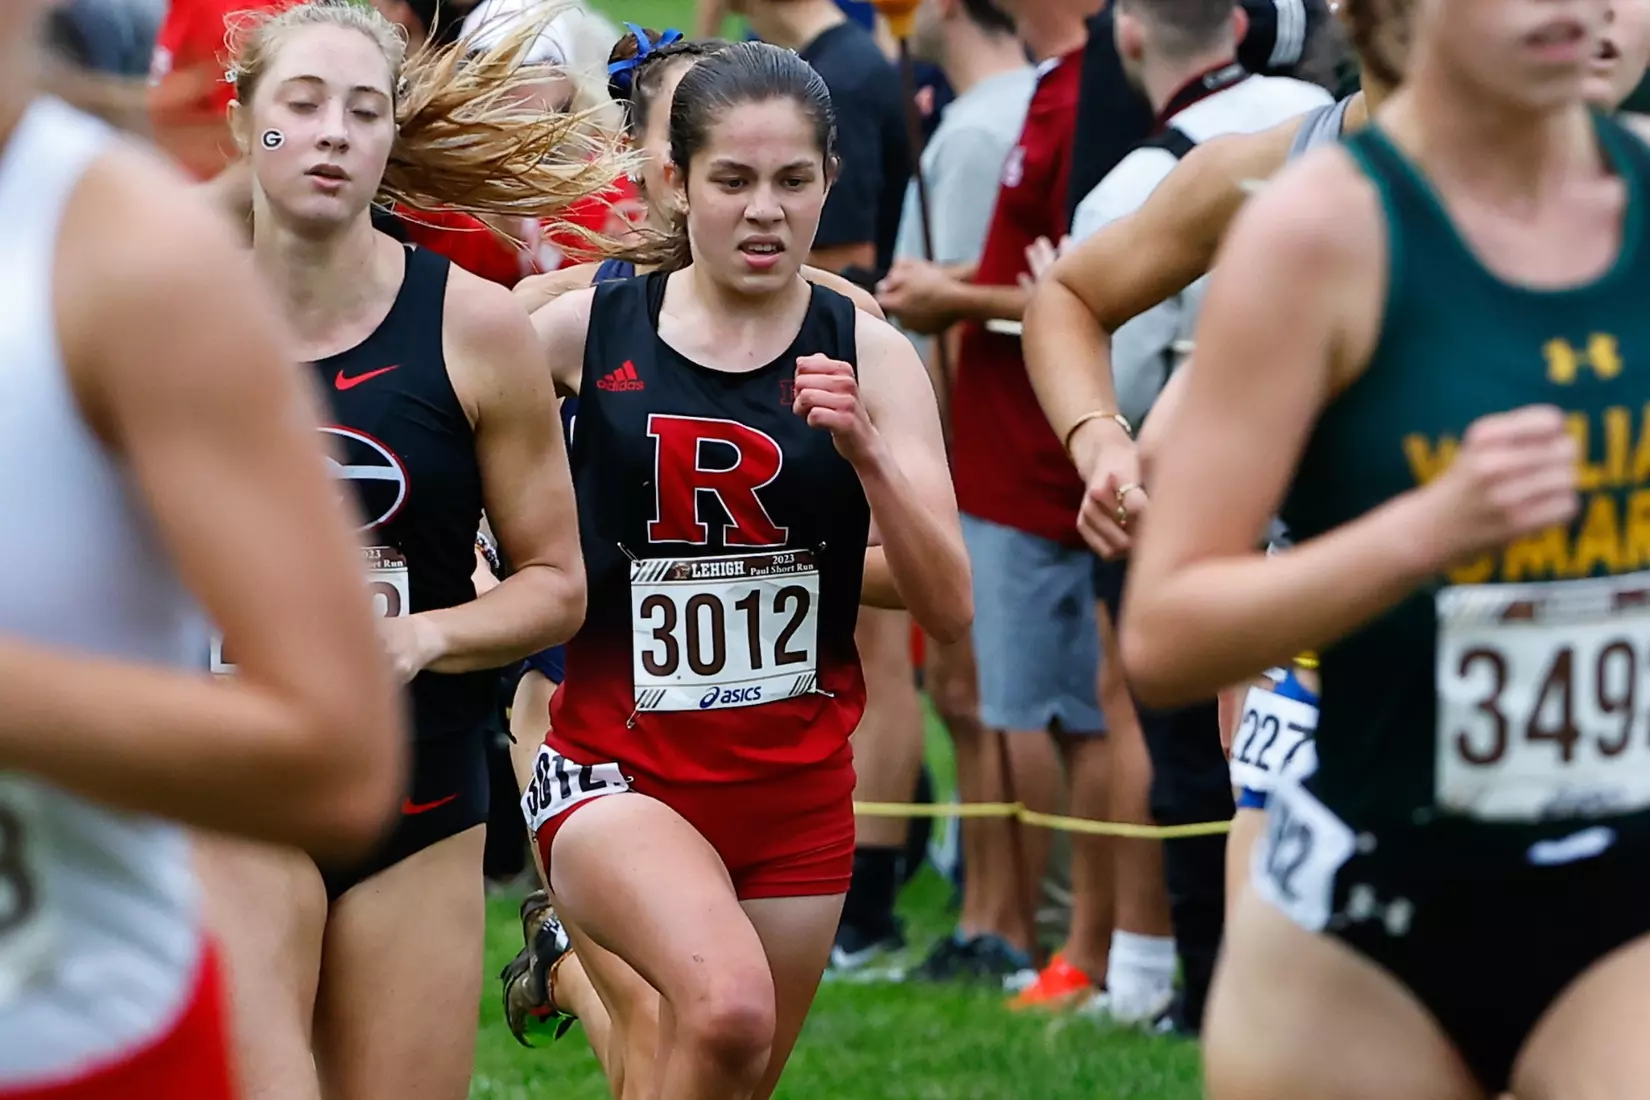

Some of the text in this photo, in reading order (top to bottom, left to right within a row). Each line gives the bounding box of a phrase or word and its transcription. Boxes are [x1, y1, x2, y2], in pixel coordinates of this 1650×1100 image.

[263, 130, 282, 148] G
[596, 379, 645, 392] adidas
[647, 413, 788, 547] R
[383, 559, 404, 568] Run
[772, 554, 795, 565] 2023
[691, 560, 745, 578] LEHIGH
[750, 562, 814, 576] Paul Short Run
[640, 585, 811, 677] 3012
[720, 686, 762, 704] asics
[1457, 639, 1650, 765] 349
